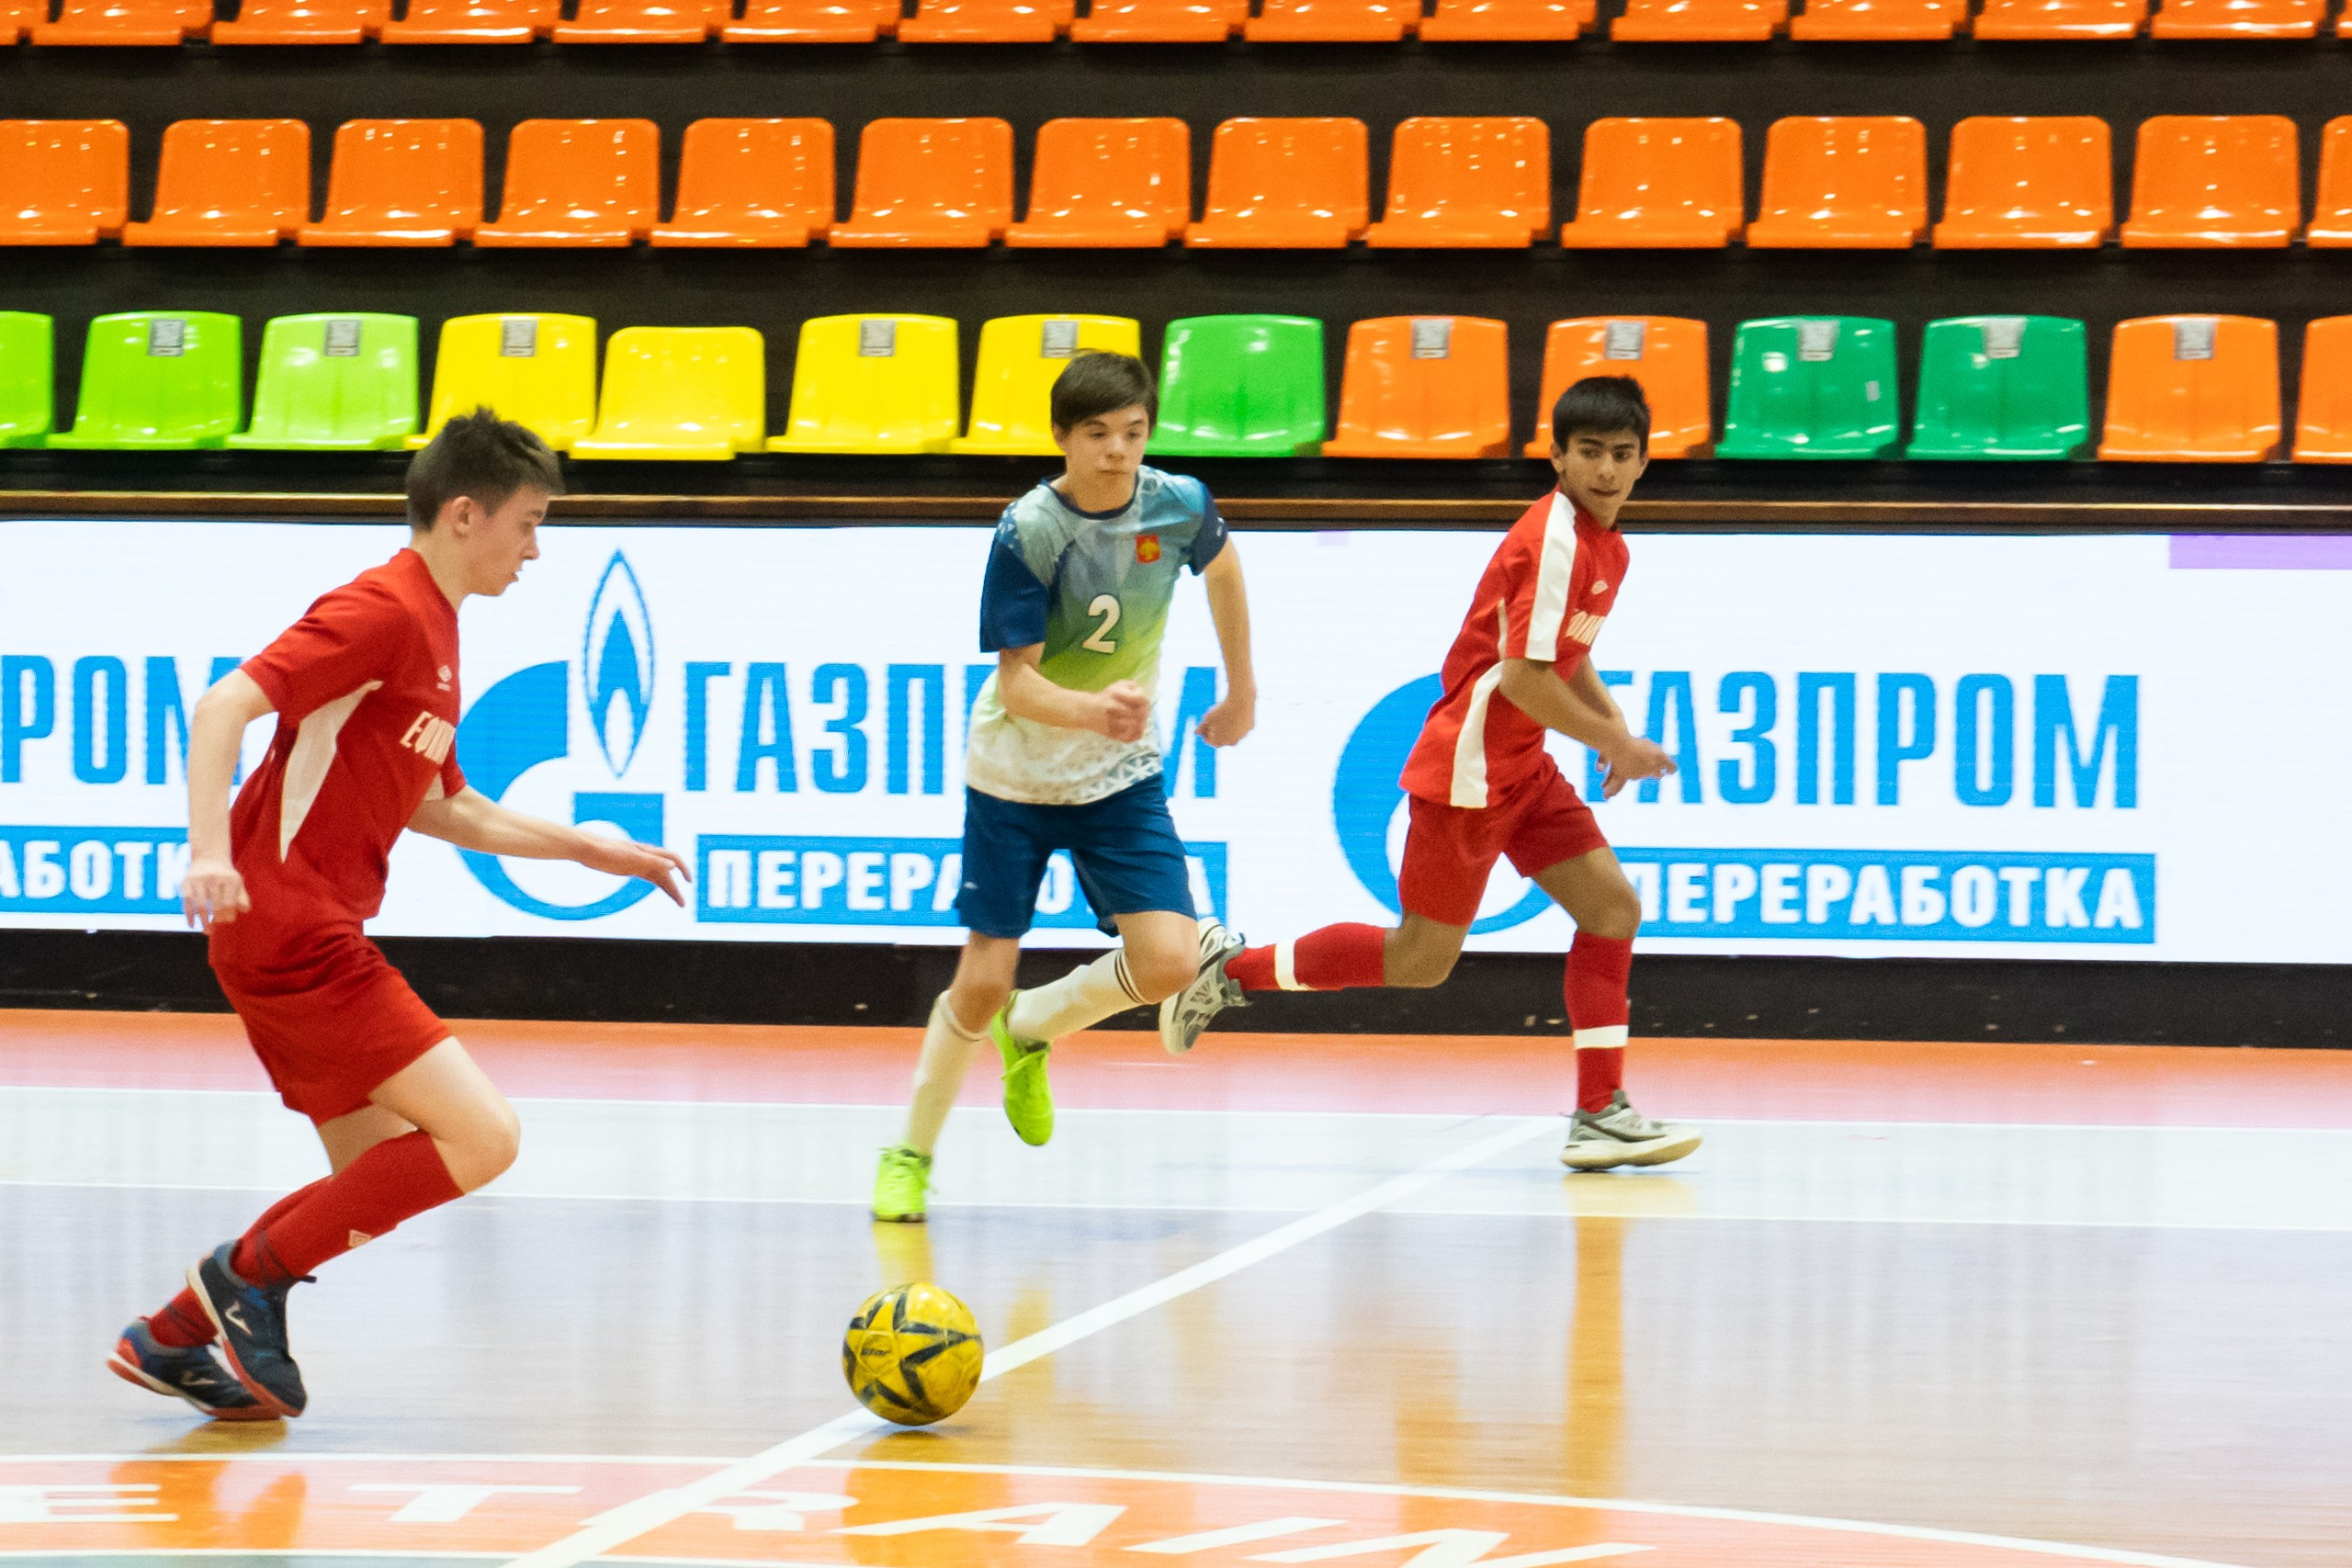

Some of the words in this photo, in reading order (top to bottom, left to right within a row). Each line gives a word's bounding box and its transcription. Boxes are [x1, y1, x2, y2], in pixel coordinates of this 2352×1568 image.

[1082, 594, 1120, 653] 2
[685, 661, 1216, 798] ГАЗП
[1620, 862, 2143, 928] ПЕРЕРАБОТКА
